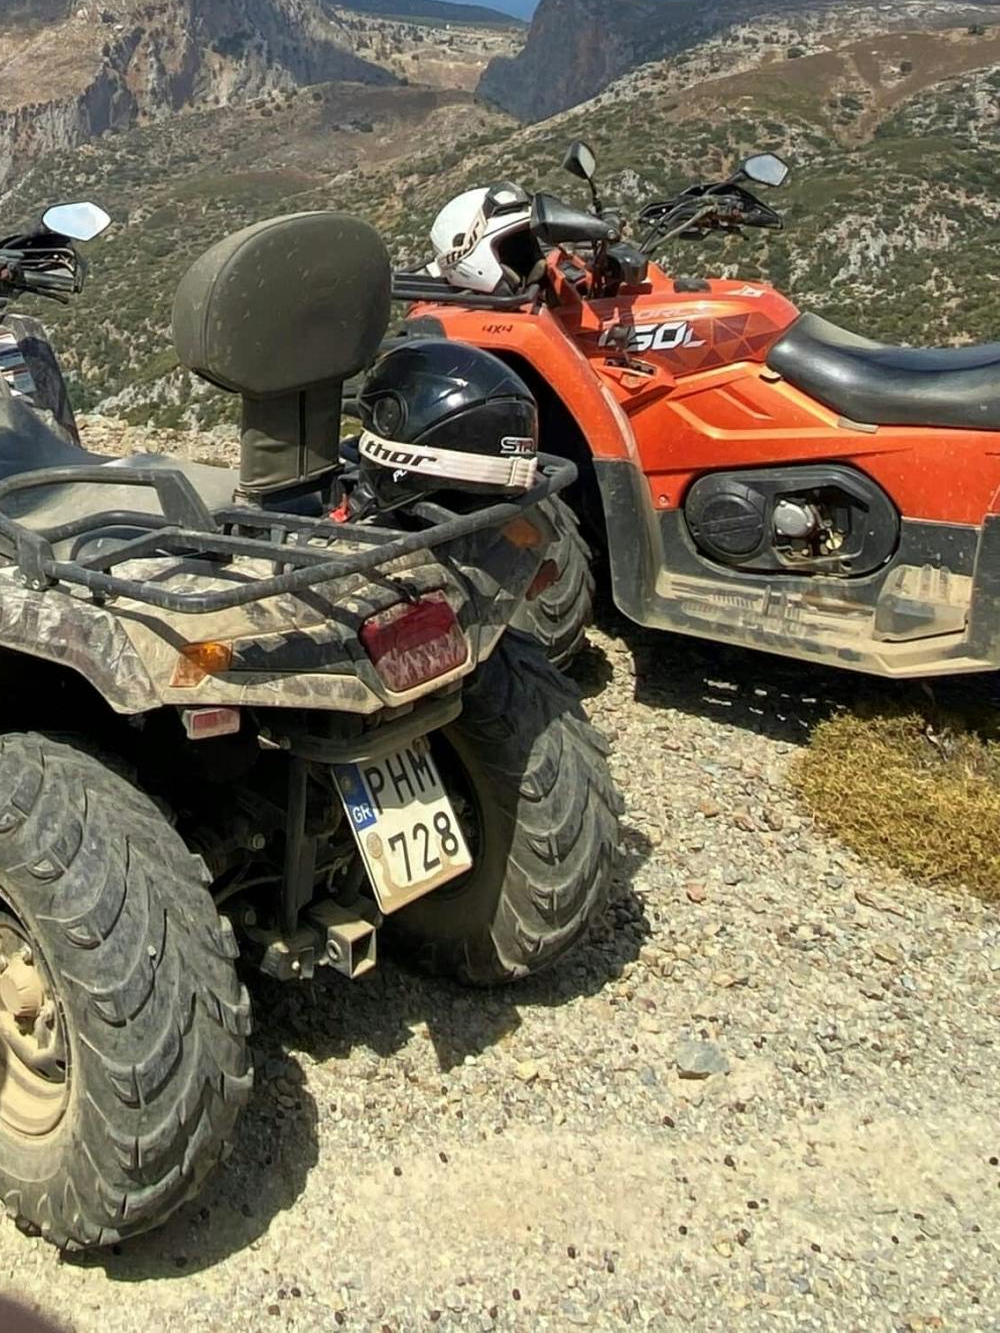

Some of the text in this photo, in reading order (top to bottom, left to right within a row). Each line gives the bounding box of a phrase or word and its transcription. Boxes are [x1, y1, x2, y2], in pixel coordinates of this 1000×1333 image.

[365, 440, 437, 467] thor
[364, 749, 437, 815] PHM
[352, 803, 373, 824] GR
[388, 811, 459, 882] 728
